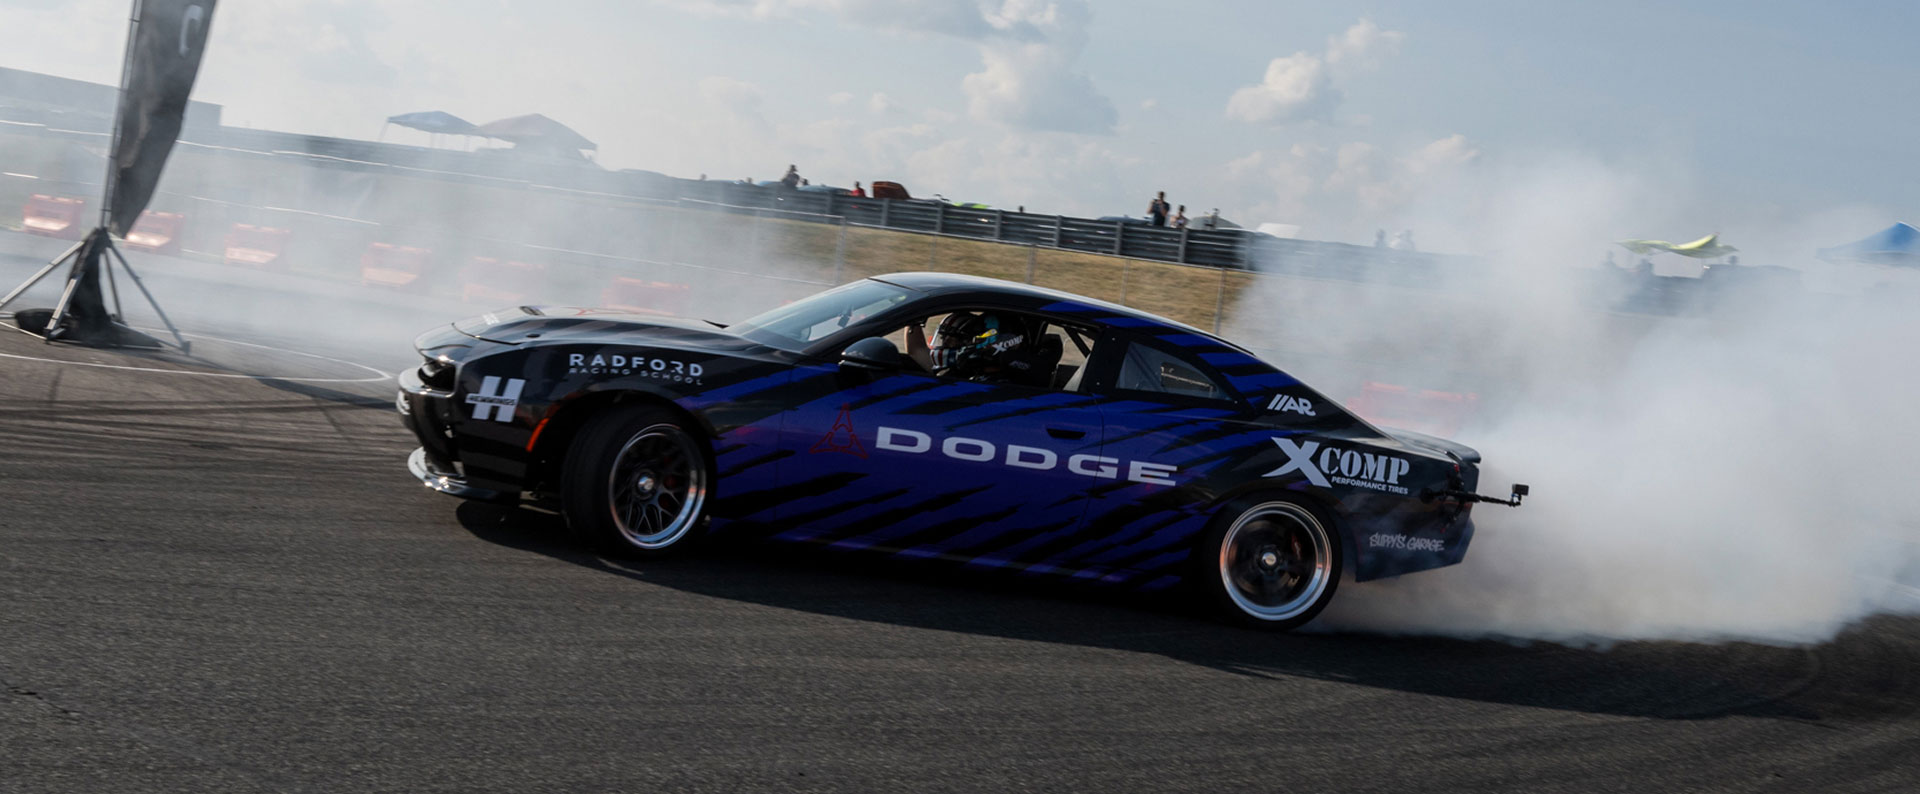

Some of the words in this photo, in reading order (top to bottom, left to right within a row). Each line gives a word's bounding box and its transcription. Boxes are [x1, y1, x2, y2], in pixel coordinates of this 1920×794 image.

[569, 353, 704, 377] RADFORD
[568, 367, 632, 375] RACING
[640, 370, 704, 386] SCHOOL
[876, 427, 1178, 486] DODGE
[1331, 477, 1387, 491] PERFORMANCE
[1387, 485, 1409, 495] TIRES
[1407, 536, 1445, 553] GARAGE
